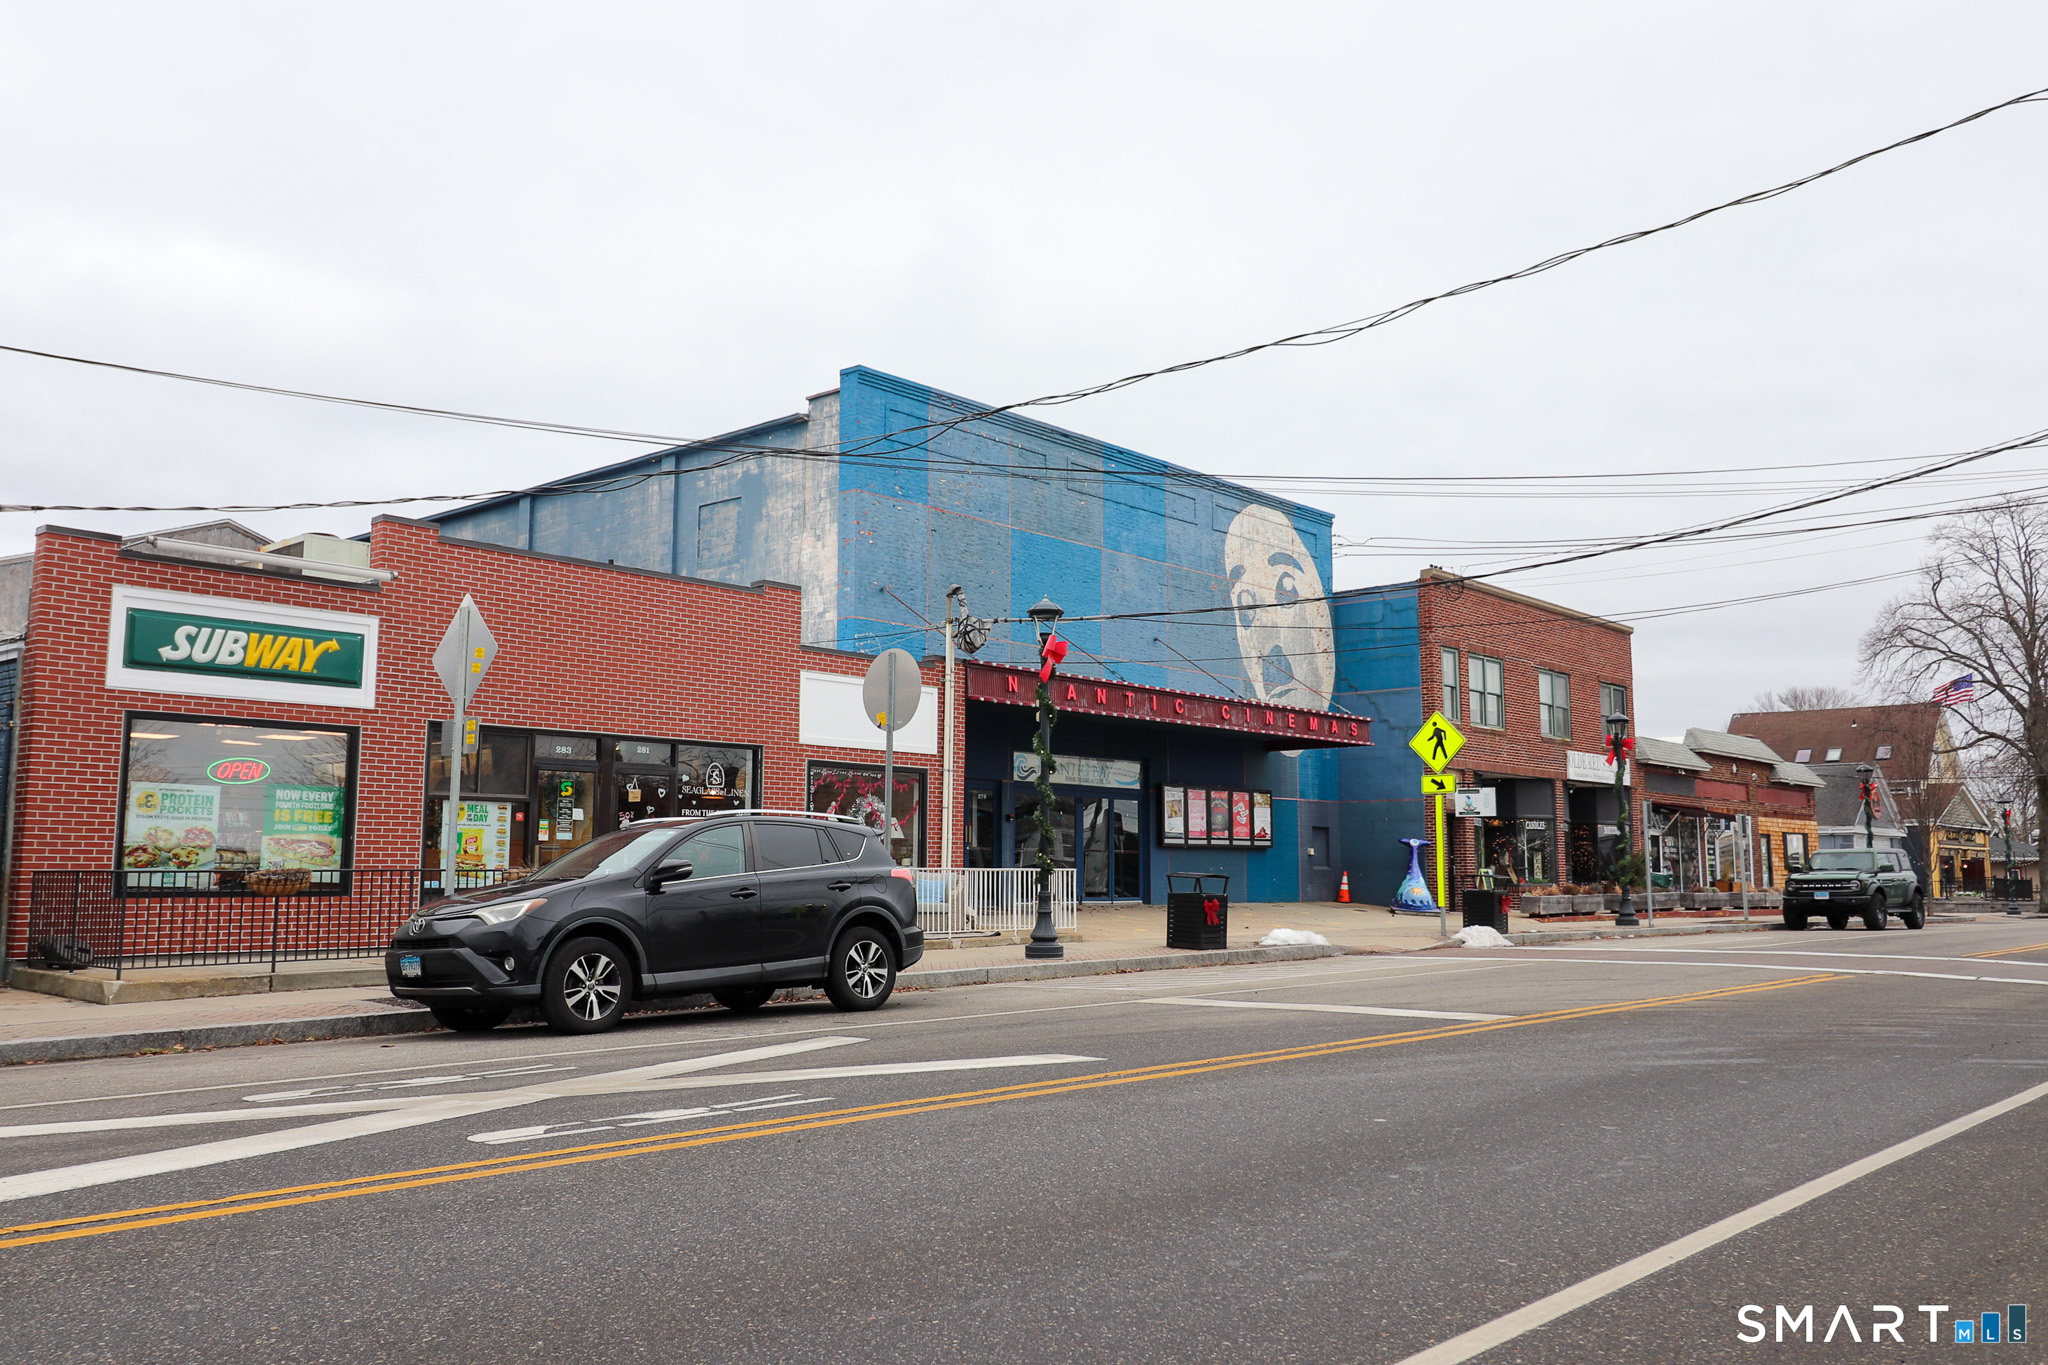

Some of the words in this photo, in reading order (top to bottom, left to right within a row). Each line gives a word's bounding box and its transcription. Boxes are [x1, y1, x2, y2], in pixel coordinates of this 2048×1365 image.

[158, 625, 340, 673] SUBWAY
[1007, 675, 1184, 714] NANTIC
[1222, 705, 1358, 737] CINEMAS
[555, 746, 572, 755] 283
[637, 746, 650, 754] 281
[216, 762, 264, 780] OPEN
[160, 792, 214, 807] PROTEIN
[275, 789, 302, 801] NOW
[302, 790, 334, 802] EVERY
[159, 805, 213, 815] POCKETS
[275, 801, 300, 809] FOURTH
[466, 804, 489, 813] MEAL
[274, 809, 291, 822] IS
[294, 809, 334, 823] FREE
[681, 808, 701, 816] FROM
[473, 813, 489, 822] DAY
